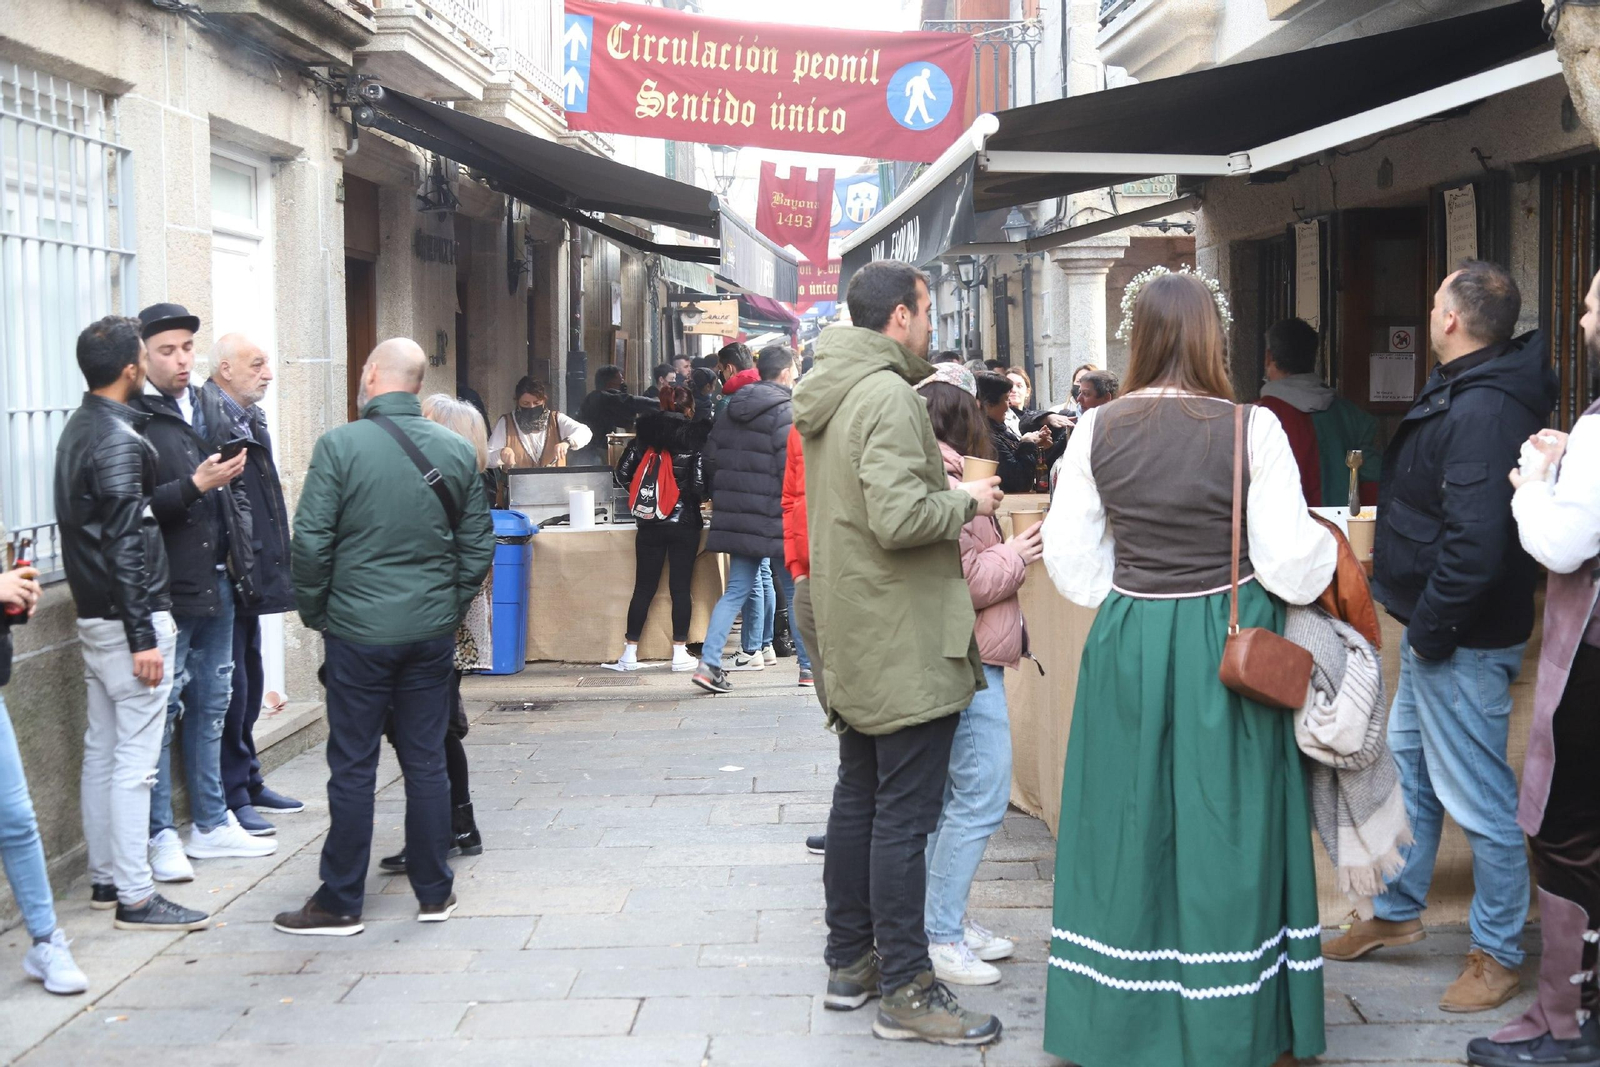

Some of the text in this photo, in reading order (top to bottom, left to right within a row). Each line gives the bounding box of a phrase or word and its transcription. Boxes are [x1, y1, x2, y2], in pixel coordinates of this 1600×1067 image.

[606, 21, 880, 85] Circulación peonil
[635, 78, 846, 135] Sentido único
[1129, 184, 1146, 193] DA
[776, 212, 813, 228] 1493
[809, 280, 838, 295] único
